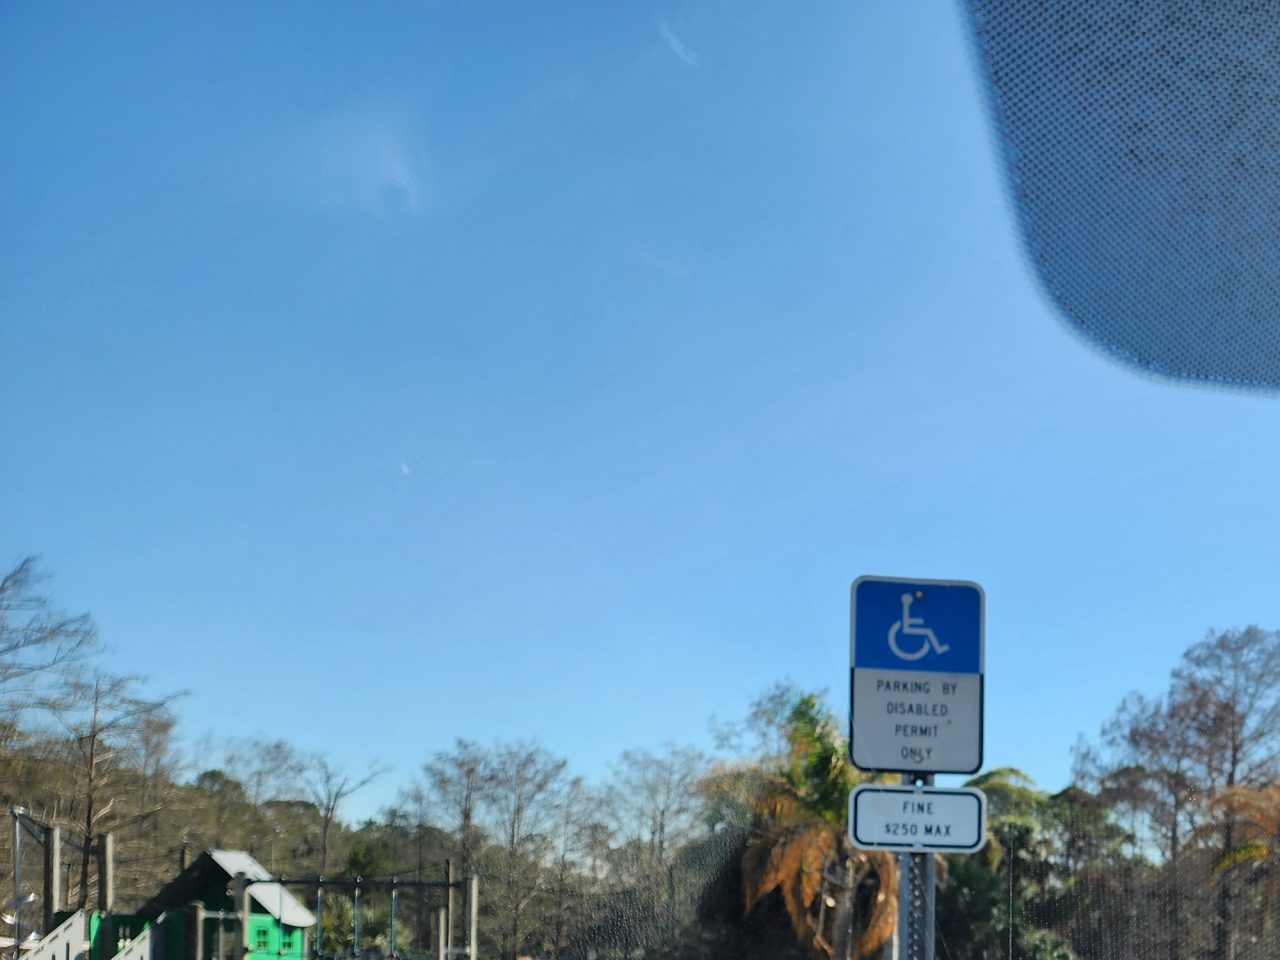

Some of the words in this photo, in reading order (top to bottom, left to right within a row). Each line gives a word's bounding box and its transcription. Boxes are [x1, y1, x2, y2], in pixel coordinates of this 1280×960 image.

[877, 680, 931, 695] PARKING
[942, 682, 958, 695] BY
[886, 702, 948, 717] DISABLED
[895, 724, 939, 738] PERMIT
[901, 747, 933, 760] ONLY
[903, 802, 934, 815] FINE
[885, 823, 918, 837] $250
[924, 824, 952, 837] MAX
